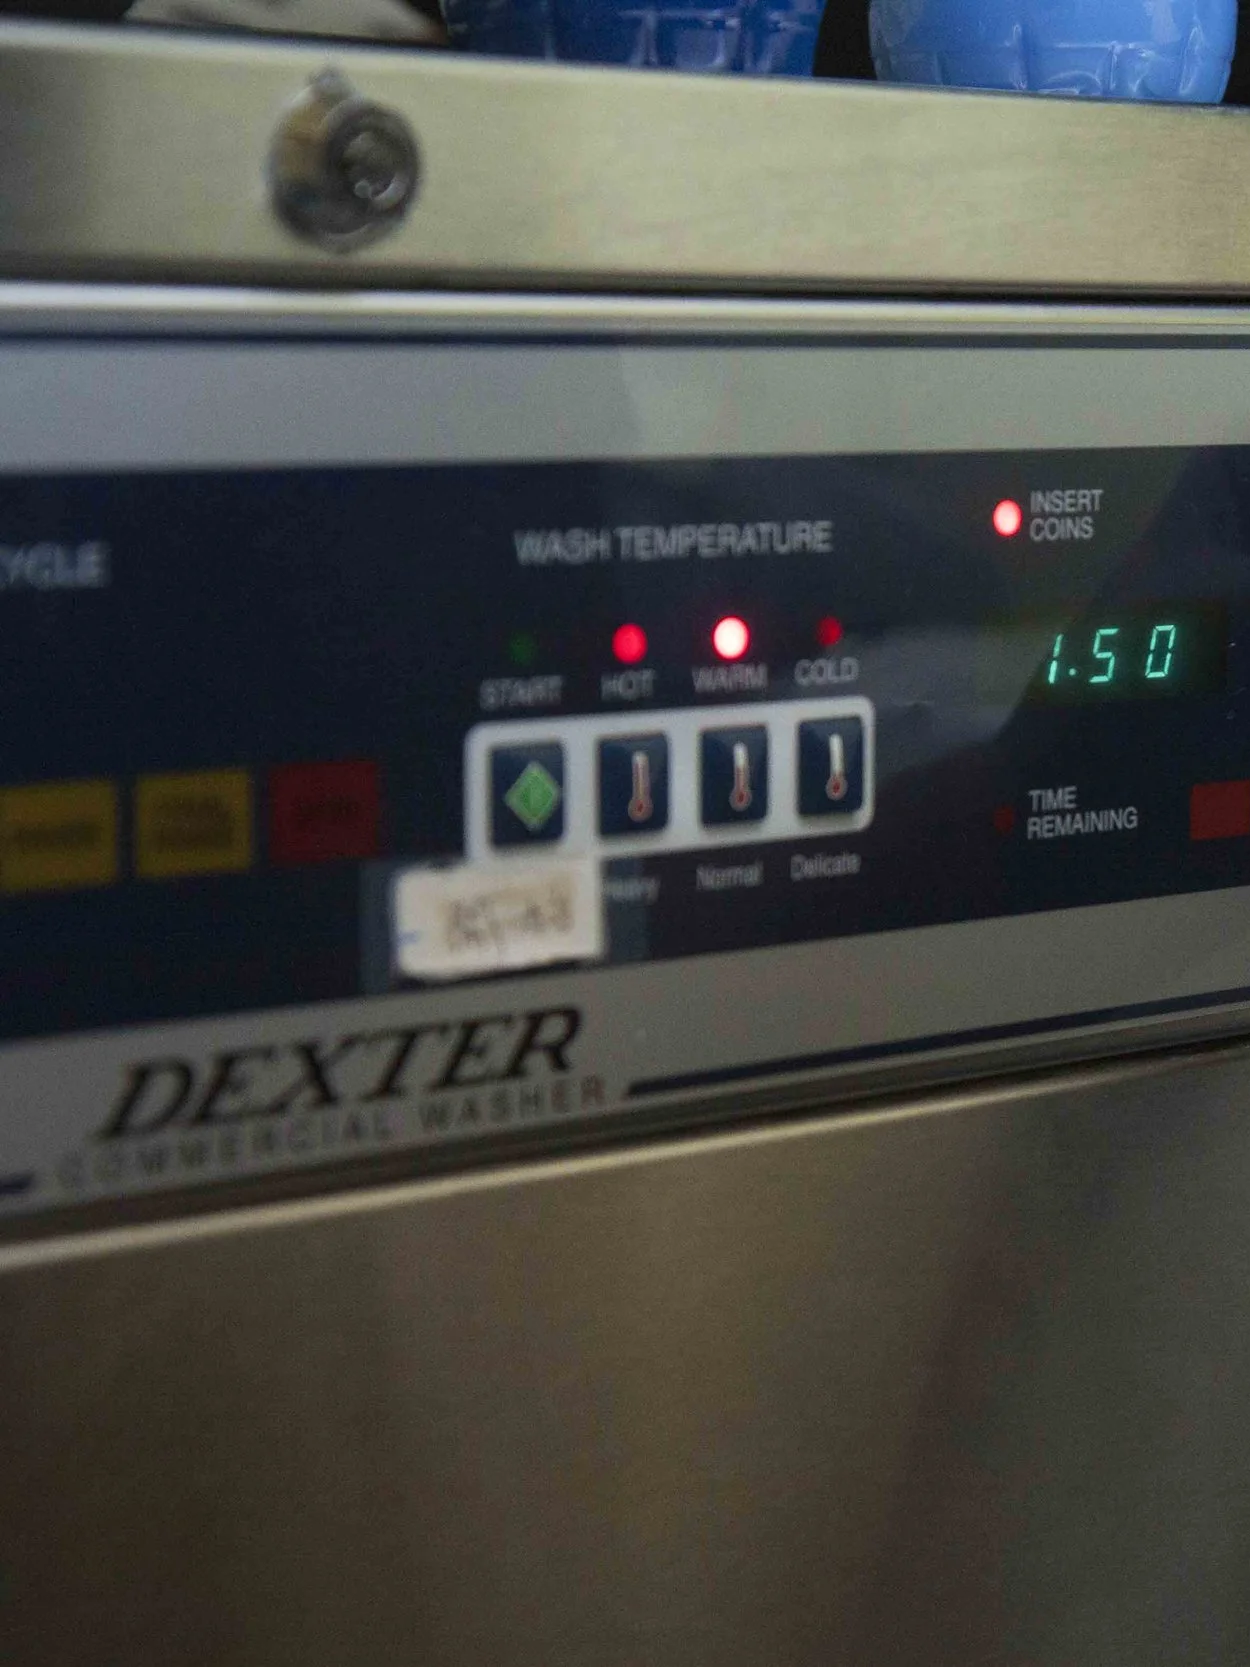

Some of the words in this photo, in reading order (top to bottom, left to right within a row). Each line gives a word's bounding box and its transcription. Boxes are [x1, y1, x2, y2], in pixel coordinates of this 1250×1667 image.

[1030, 489, 1103, 513] INSERT
[513, 526, 610, 566] WASH
[615, 519, 834, 561] TEMPERATURE
[1029, 516, 1094, 542] COINS
[0, 540, 110, 591] YCLE
[1048, 624, 1177, 684] 1.50
[602, 669, 655, 701] HOT
[692, 662, 768, 695] WARM
[794, 657, 860, 687] COLD
[1029, 785, 1078, 811] TIME
[1027, 806, 1138, 841] REMAINING
[696, 860, 764, 890] Normal
[790, 850, 862, 884] Delicate
[92, 1004, 585, 1141] DEXTER
[419, 1075, 608, 1133] WASHER
